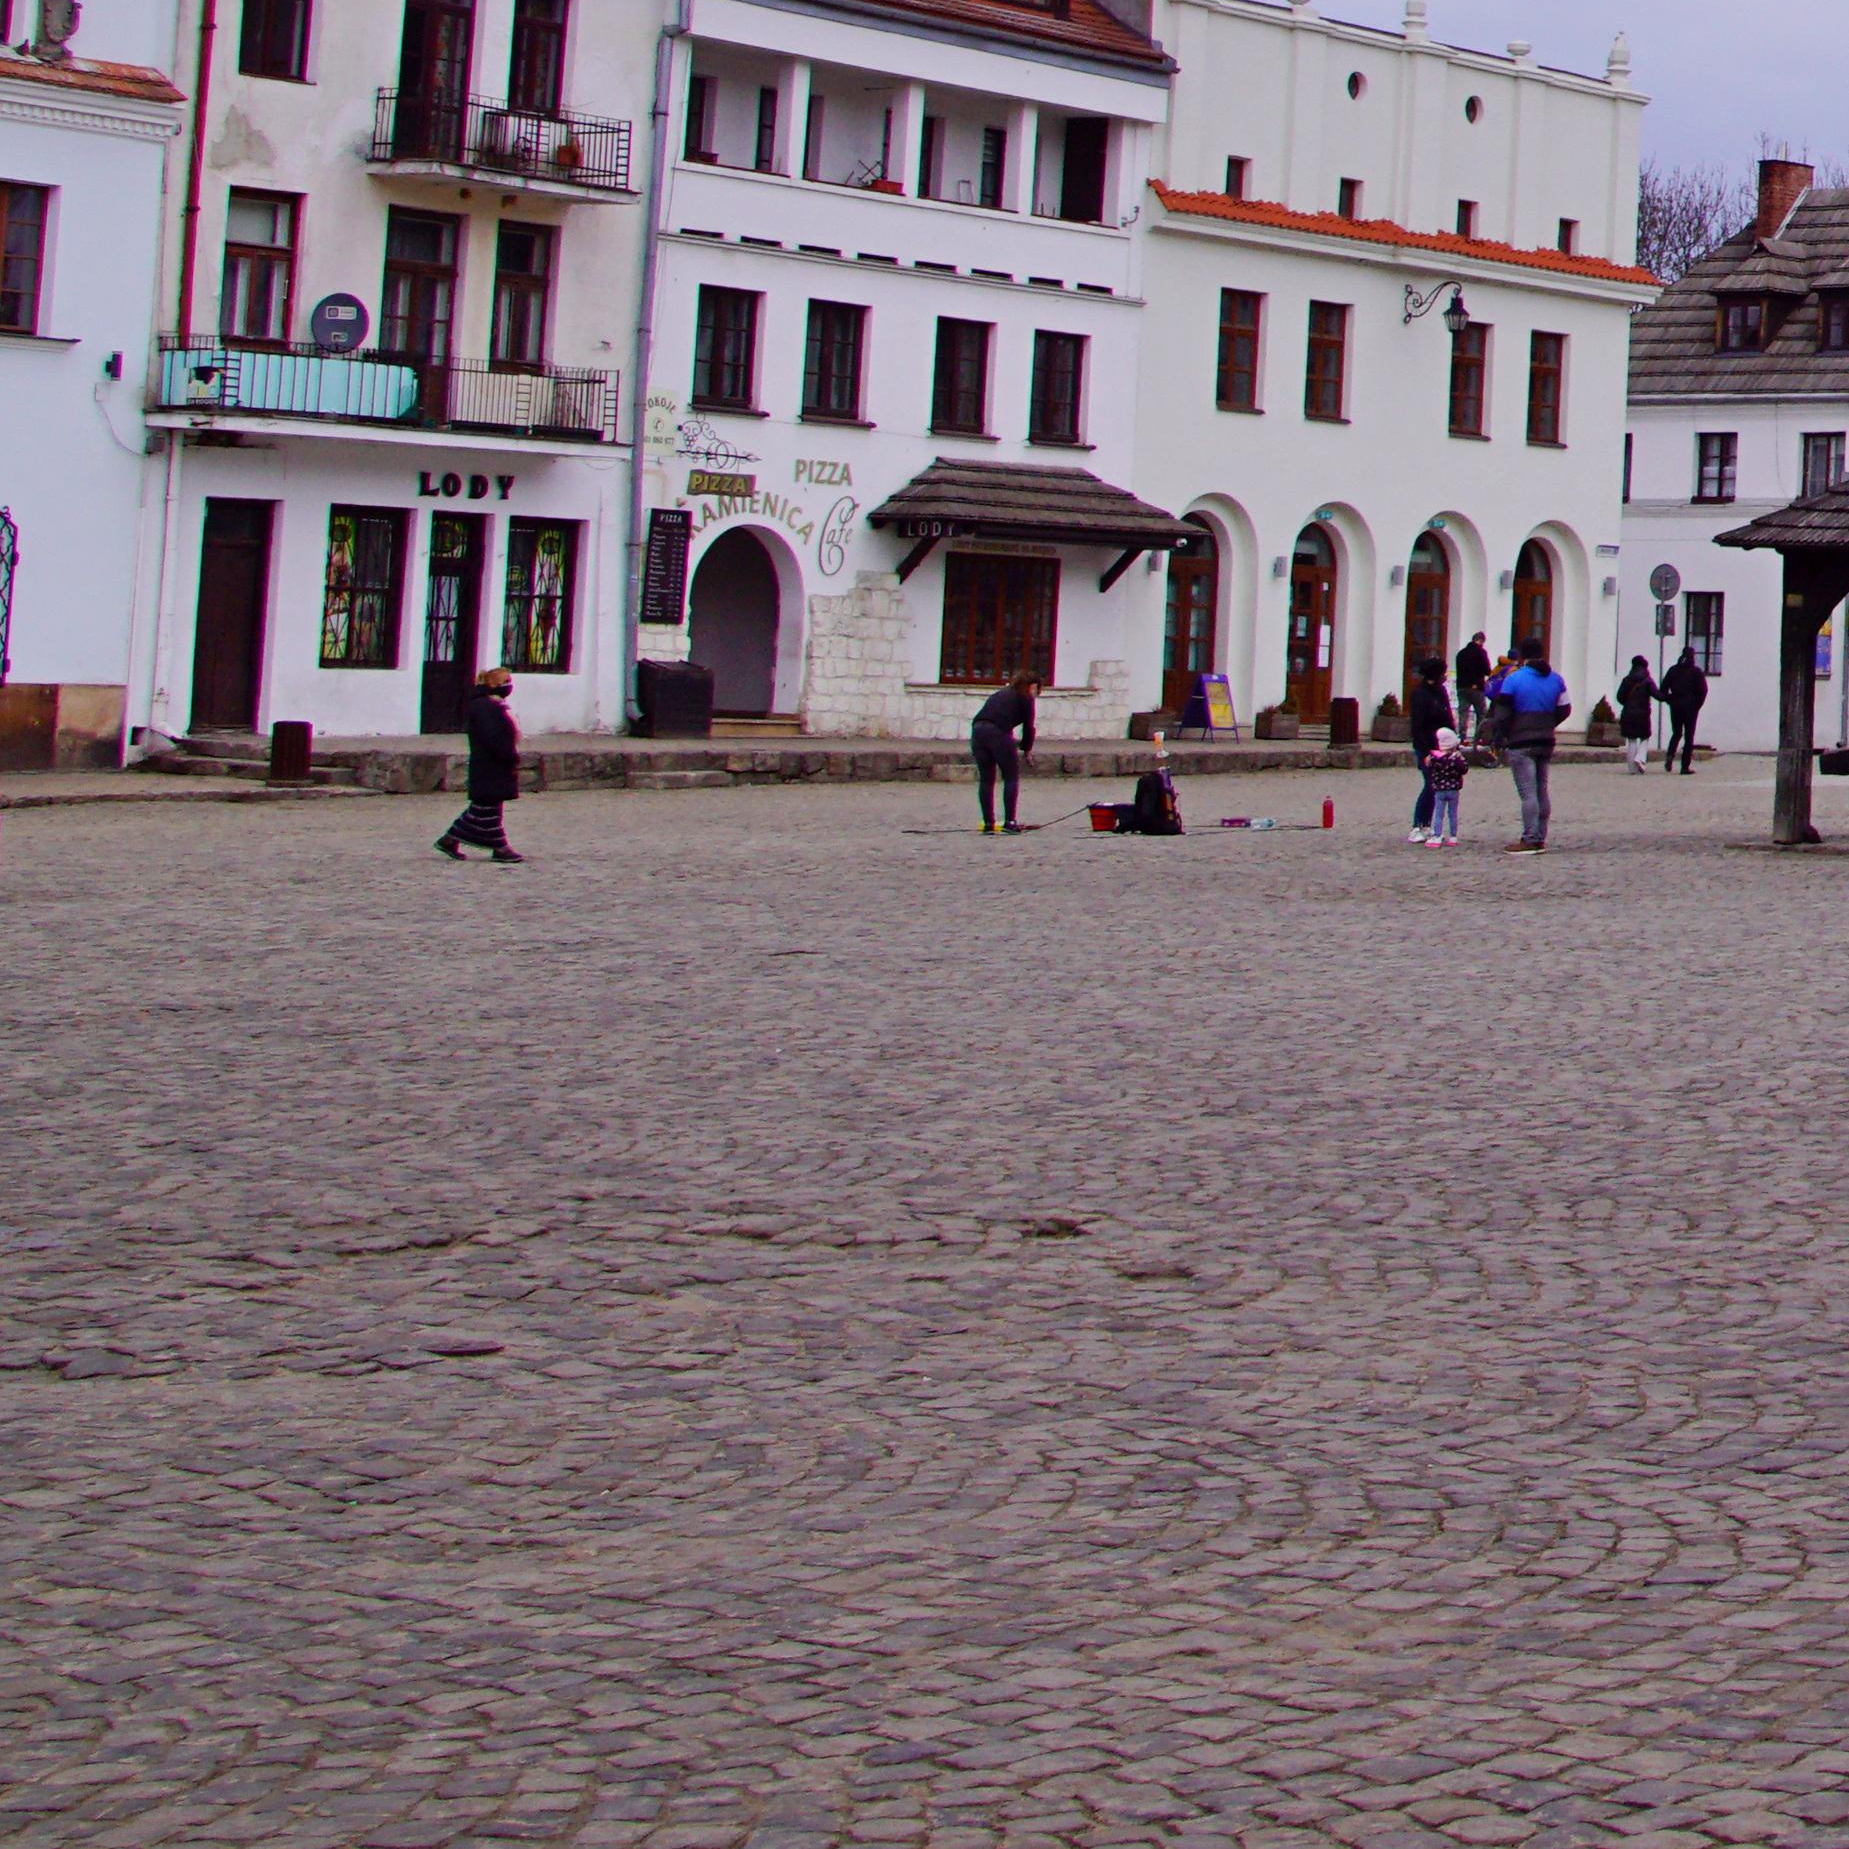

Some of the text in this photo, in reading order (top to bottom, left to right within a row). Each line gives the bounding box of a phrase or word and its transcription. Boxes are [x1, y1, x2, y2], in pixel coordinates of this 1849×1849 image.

[645, 397, 676, 415] OKOJE
[795, 459, 852, 486] PIZZA
[418, 471, 515, 500] LODY
[692, 474, 746, 493] PIZZA
[660, 514, 683, 523] PIZZA
[907, 521, 956, 537] LODY
